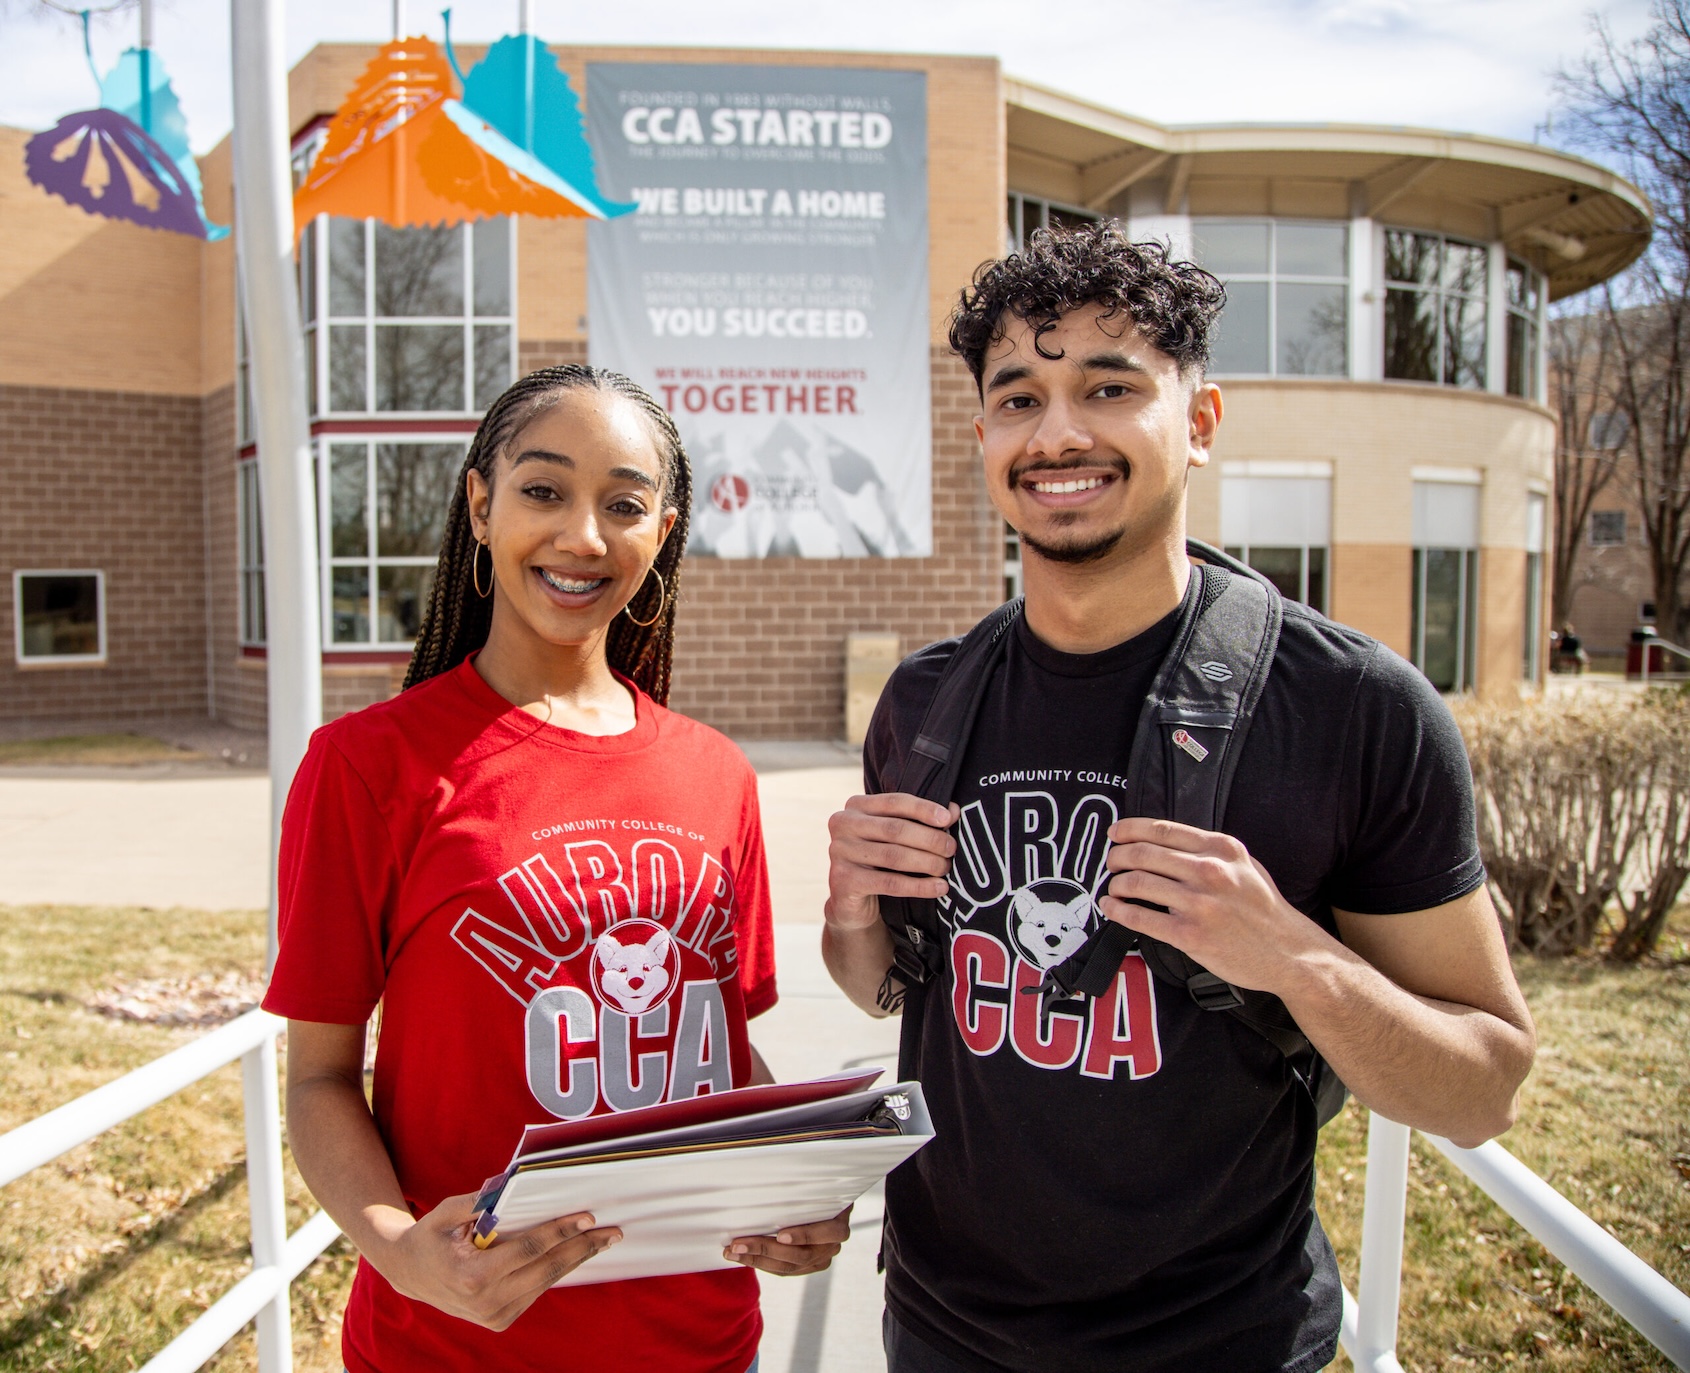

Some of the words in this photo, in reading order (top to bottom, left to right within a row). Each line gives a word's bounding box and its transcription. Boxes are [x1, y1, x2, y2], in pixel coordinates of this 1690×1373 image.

[622, 107, 704, 145] CCA
[711, 109, 893, 149] STARTED
[631, 187, 678, 215] WE
[684, 188, 768, 216] BUILT
[771, 190, 794, 217] A
[797, 190, 886, 218] HOME
[647, 308, 716, 337] YOU
[723, 308, 872, 338] SUCCEED.
[655, 367, 682, 380] WE
[684, 368, 714, 380] WILL
[719, 368, 767, 381] REACH
[771, 368, 801, 380] NEW
[805, 368, 867, 381] HEIGHTS
[978, 769, 1072, 787] COMMUNITY
[531, 819, 616, 841] COMMUNITY
[621, 820, 684, 838] COLLEGE
[688, 831, 706, 842] OF
[950, 929, 1162, 1080] CCA
[525, 978, 733, 1120] CCA
